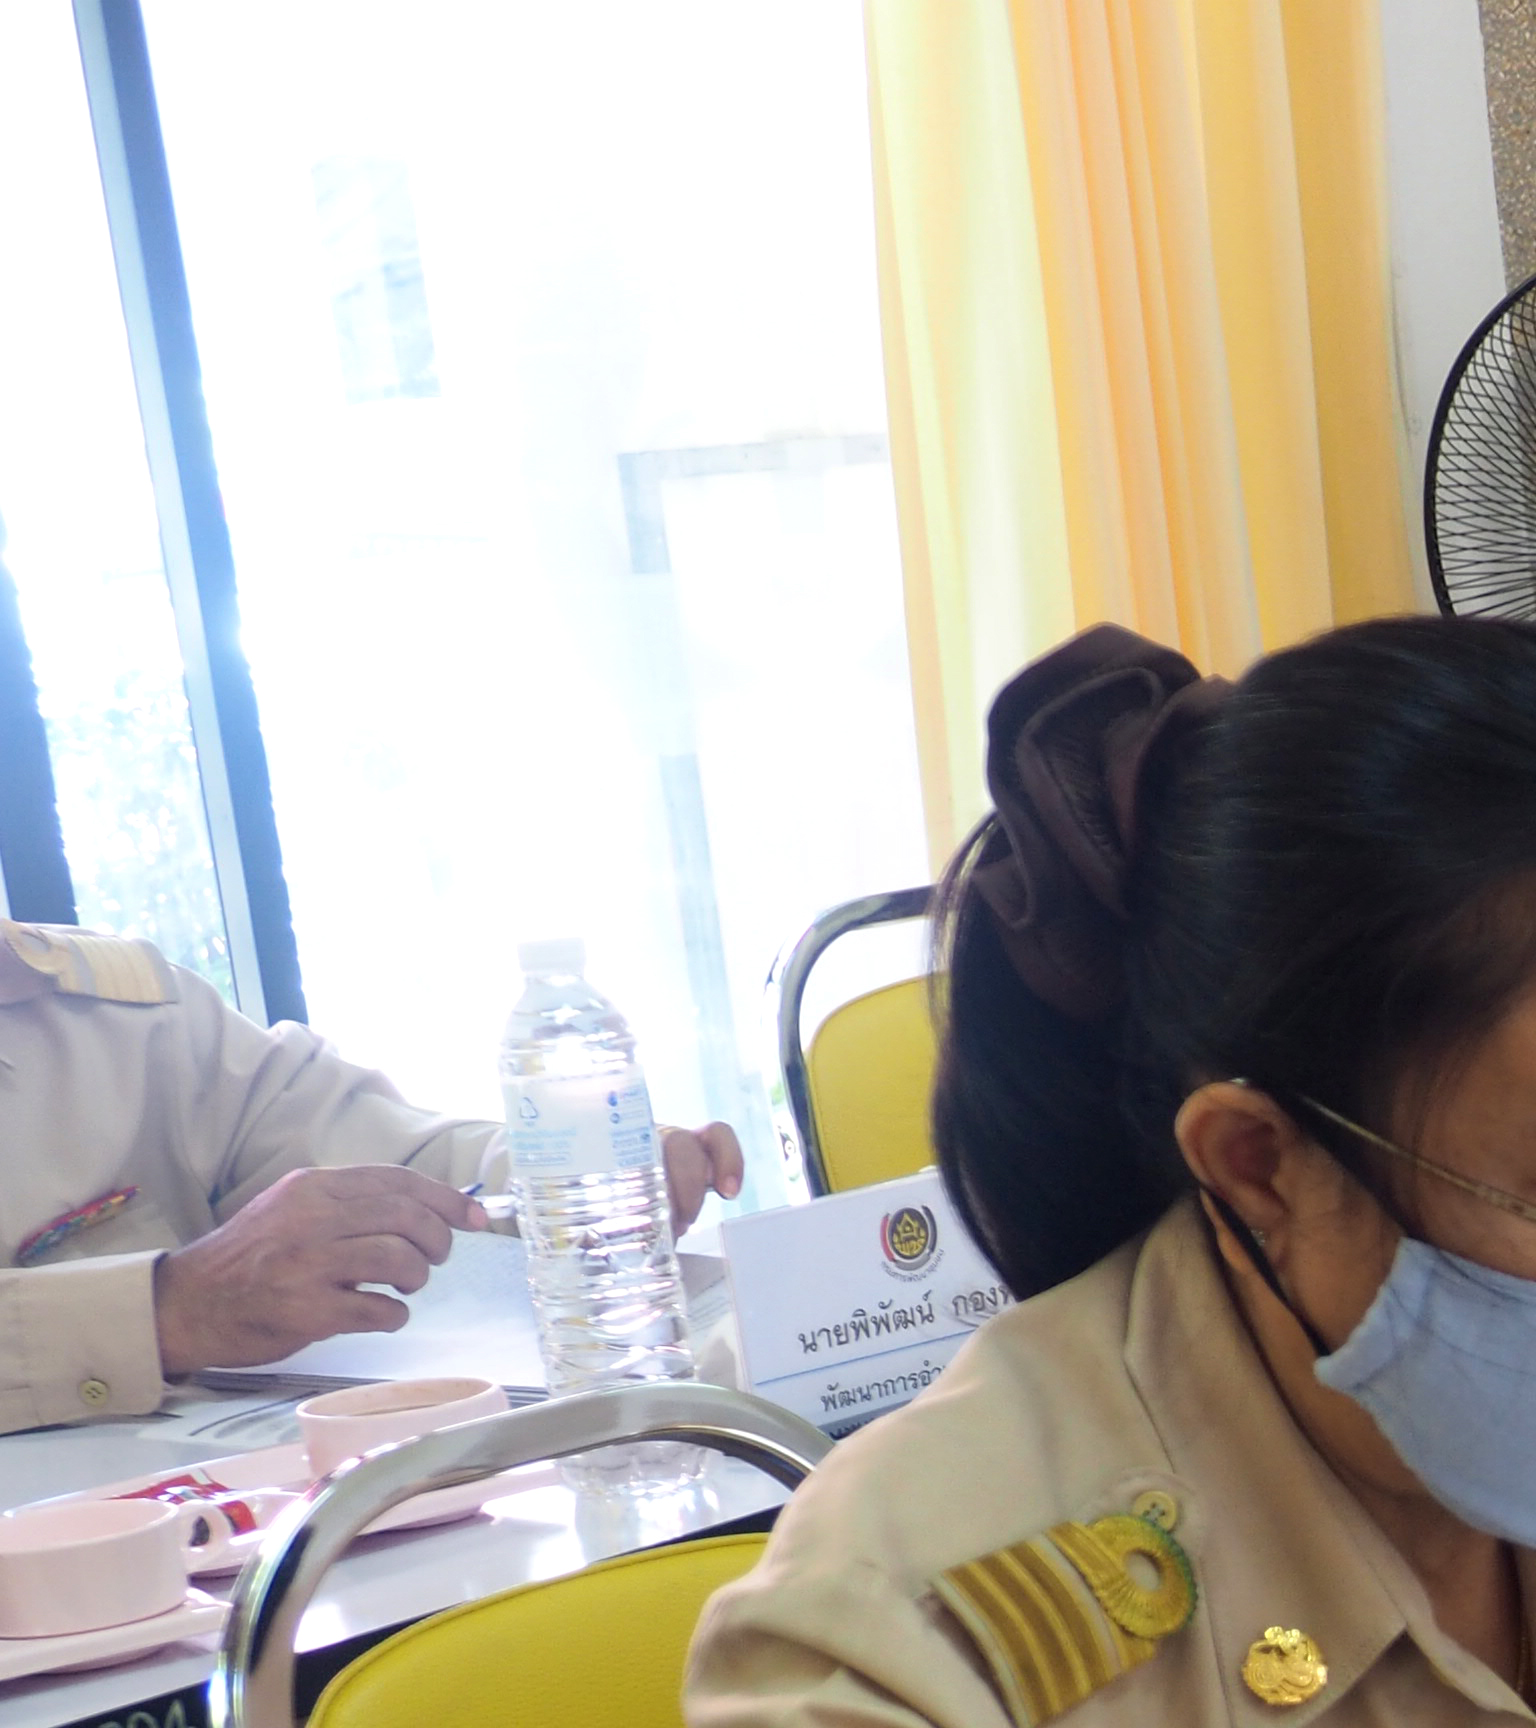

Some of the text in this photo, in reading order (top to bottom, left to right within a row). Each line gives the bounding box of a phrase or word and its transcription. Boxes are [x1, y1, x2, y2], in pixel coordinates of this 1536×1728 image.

[798, 1289, 936, 1354] นายพิพัฒน์
[821, 1360, 946, 1412] พัฒนาการอำ
